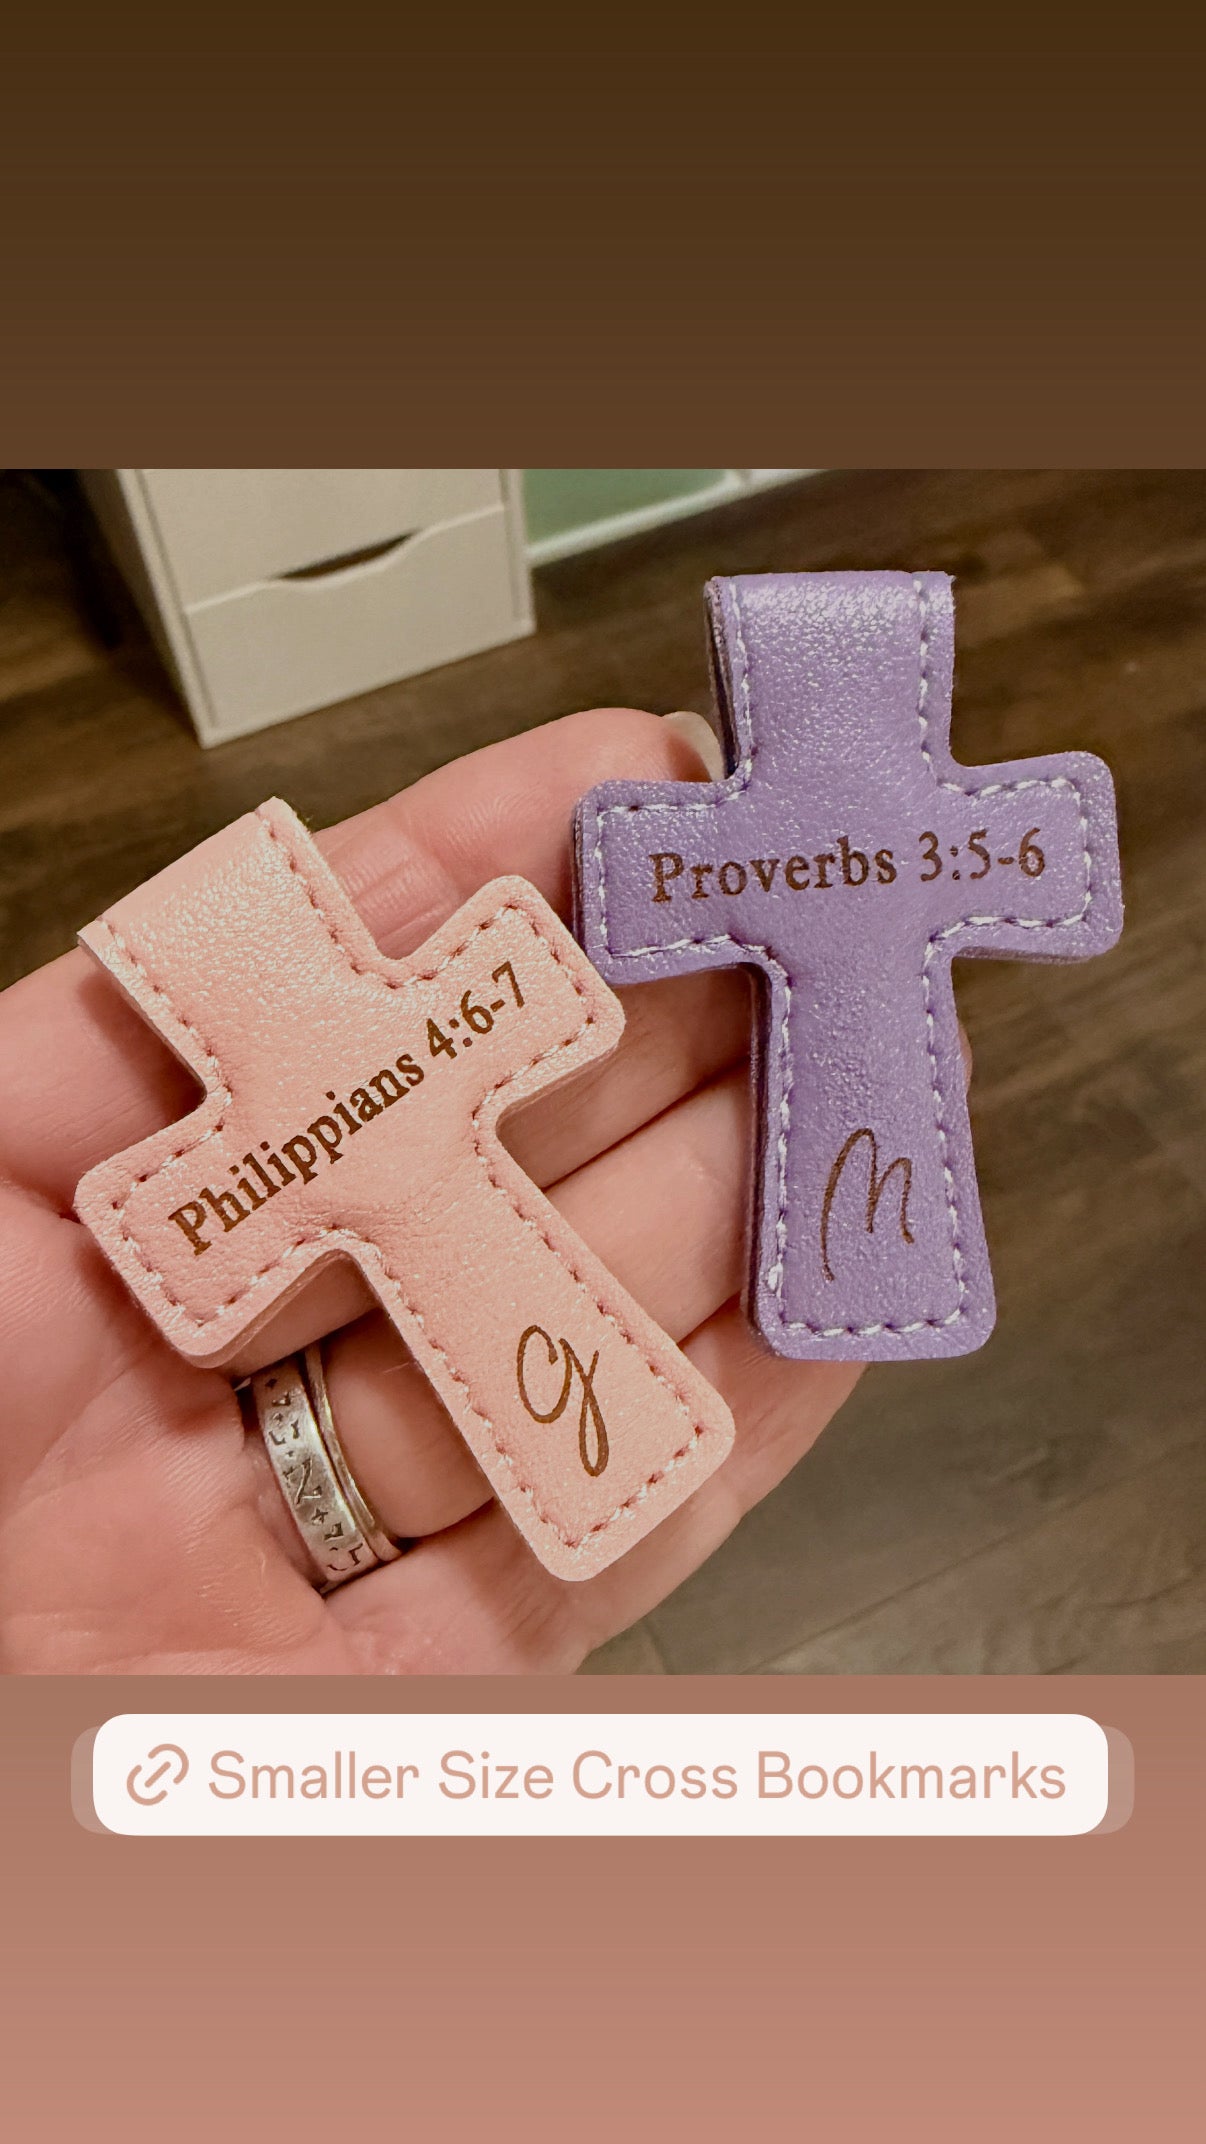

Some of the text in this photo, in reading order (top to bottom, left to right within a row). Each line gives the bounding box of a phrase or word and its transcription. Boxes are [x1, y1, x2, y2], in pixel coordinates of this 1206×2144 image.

[649, 827, 1046, 903] Proverbs 3:5-6
[167, 961, 526, 1255] Philippians 4:6-7
